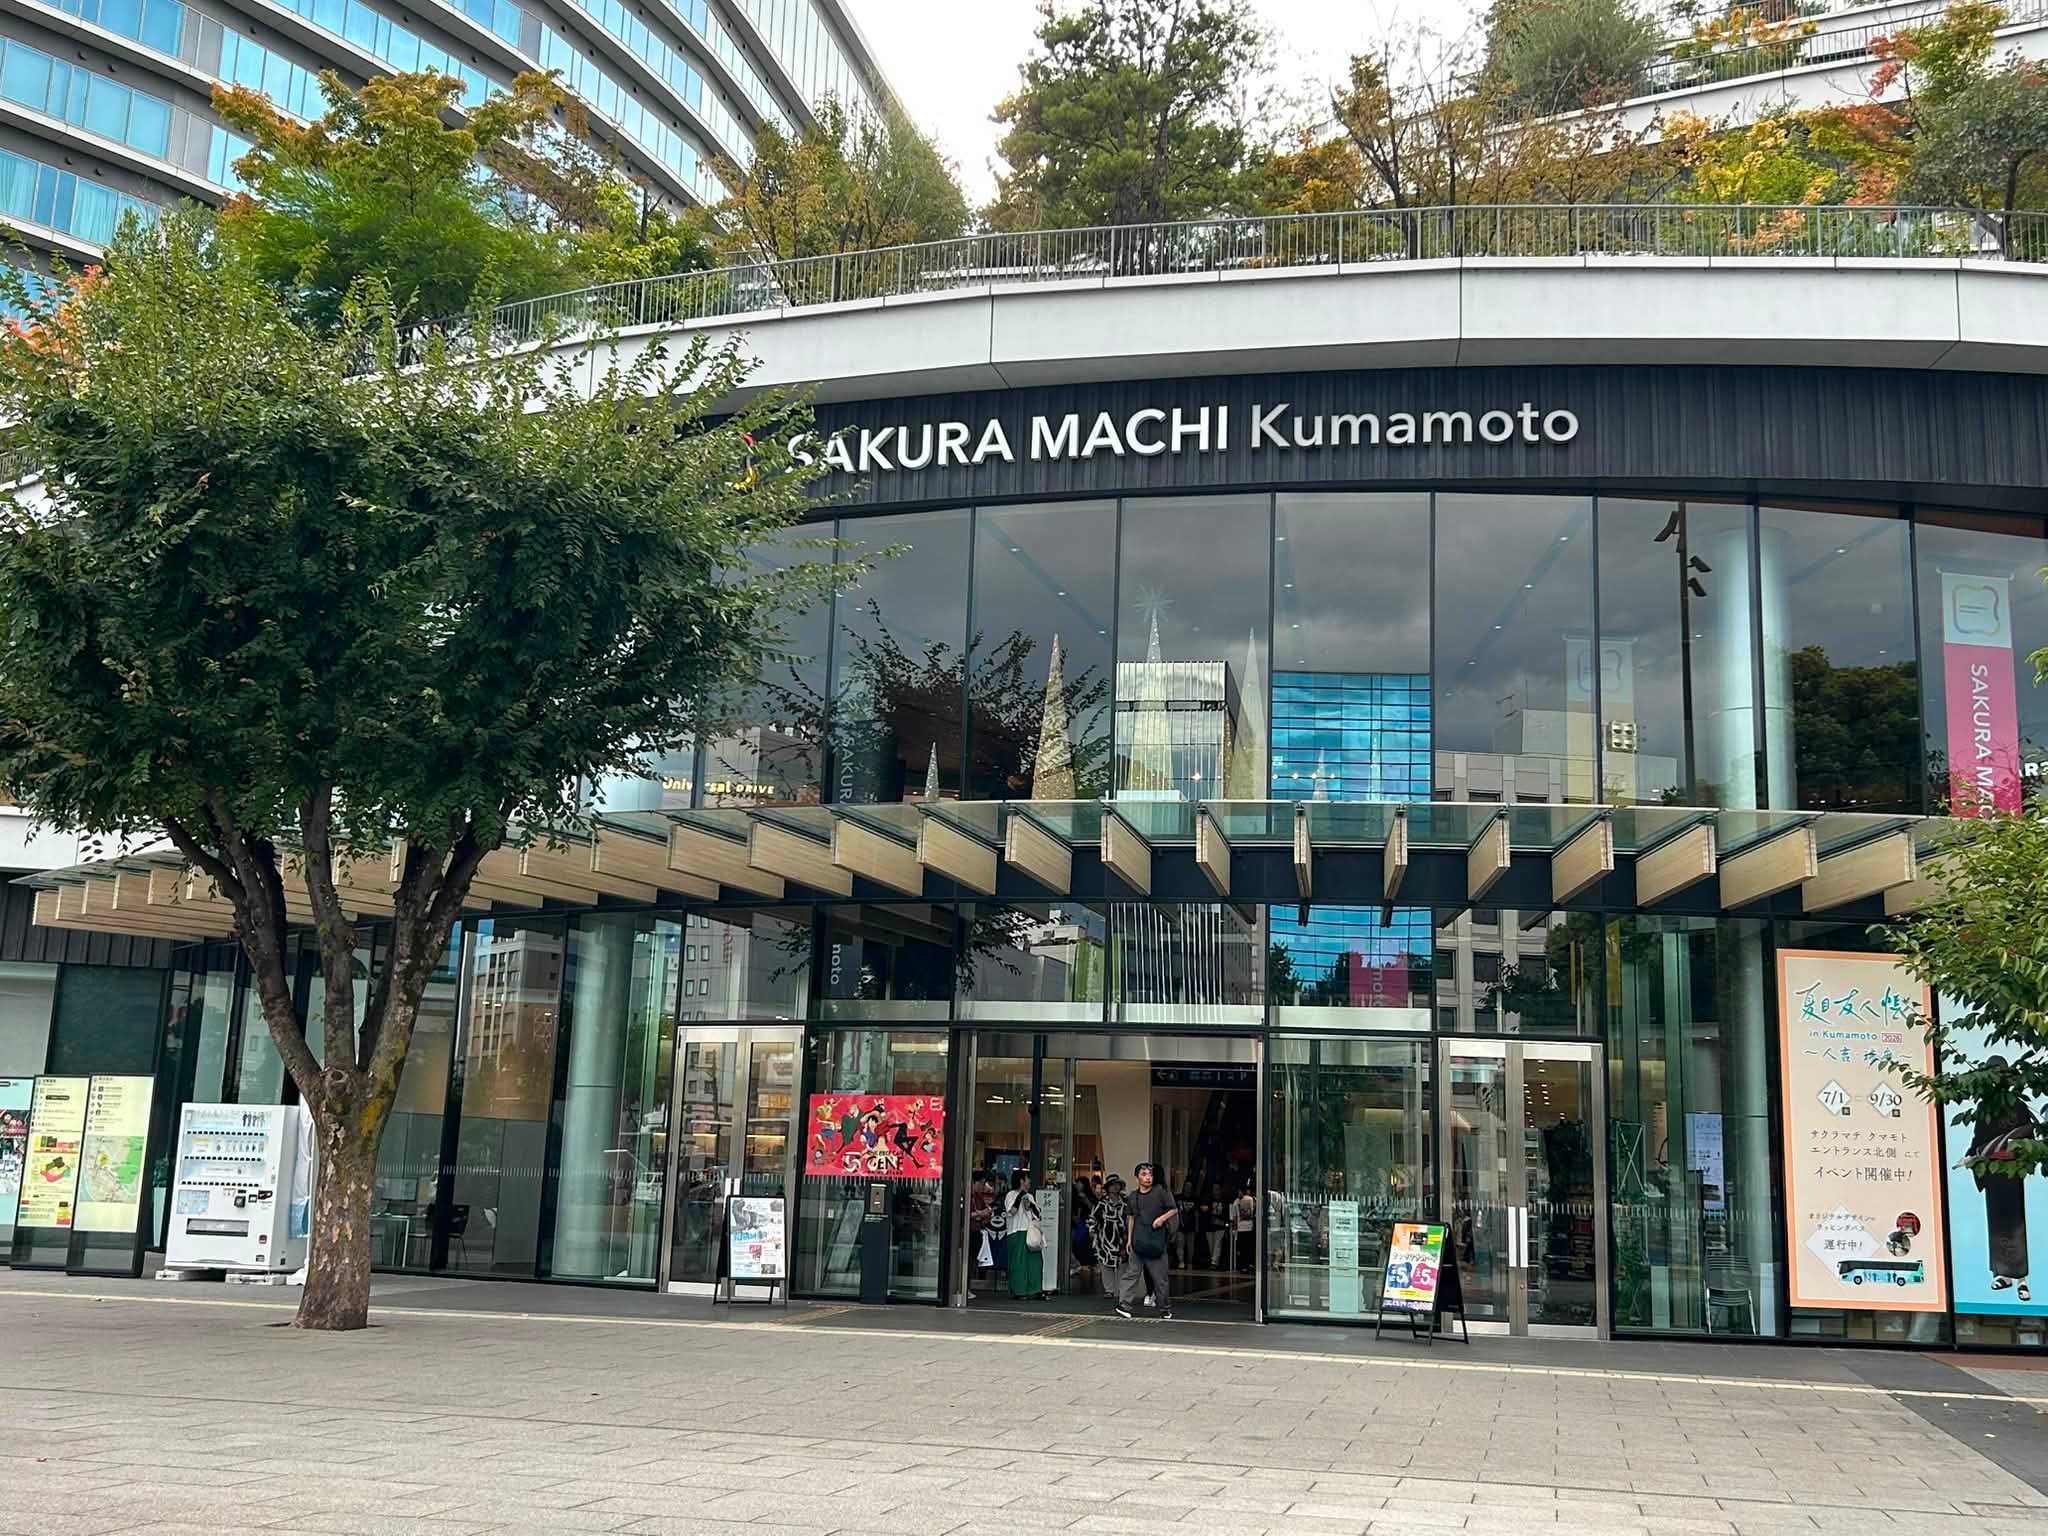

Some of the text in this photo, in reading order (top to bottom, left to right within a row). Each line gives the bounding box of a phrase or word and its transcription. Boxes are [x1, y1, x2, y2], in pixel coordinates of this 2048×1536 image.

[785, 400, 1581, 475] SAKURA MACHI Kumamoto
[1971, 664, 1992, 760] SAKURA
[735, 783, 775, 794] DRIVE
[1794, 981, 1907, 1026] 夏目友人帳
[1822, 1030, 1878, 1041] Kumamoto
[1823, 1090, 1902, 1107] 7/1 9/30
[1810, 1130, 1908, 1143] サクラマチ クマモト
[1809, 1145, 1897, 1158] エントランス北側
